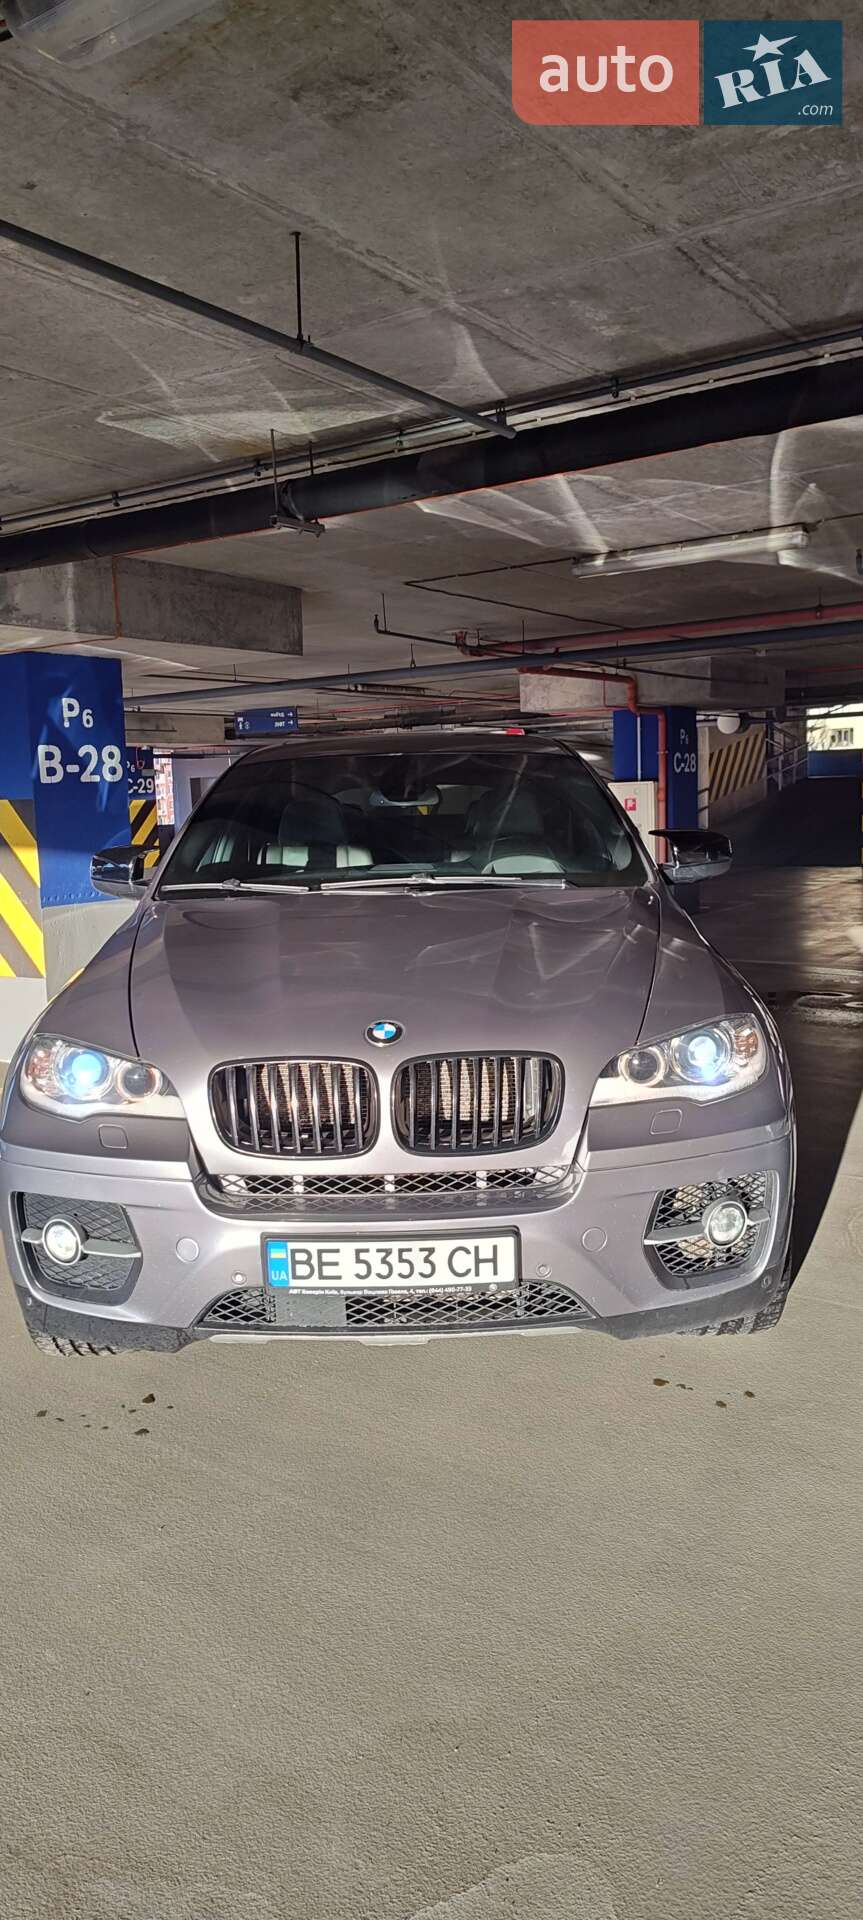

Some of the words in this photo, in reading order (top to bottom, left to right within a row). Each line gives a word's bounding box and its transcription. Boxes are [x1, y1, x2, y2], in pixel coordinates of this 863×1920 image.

[37, 745, 123, 784] B-28
[673, 752, 697, 773] C-28
[272, 1271, 288, 1281] UA
[290, 1248, 342, 1280] BE
[354, 1247, 436, 1279] 5353
[448, 1245, 498, 1277] CH
